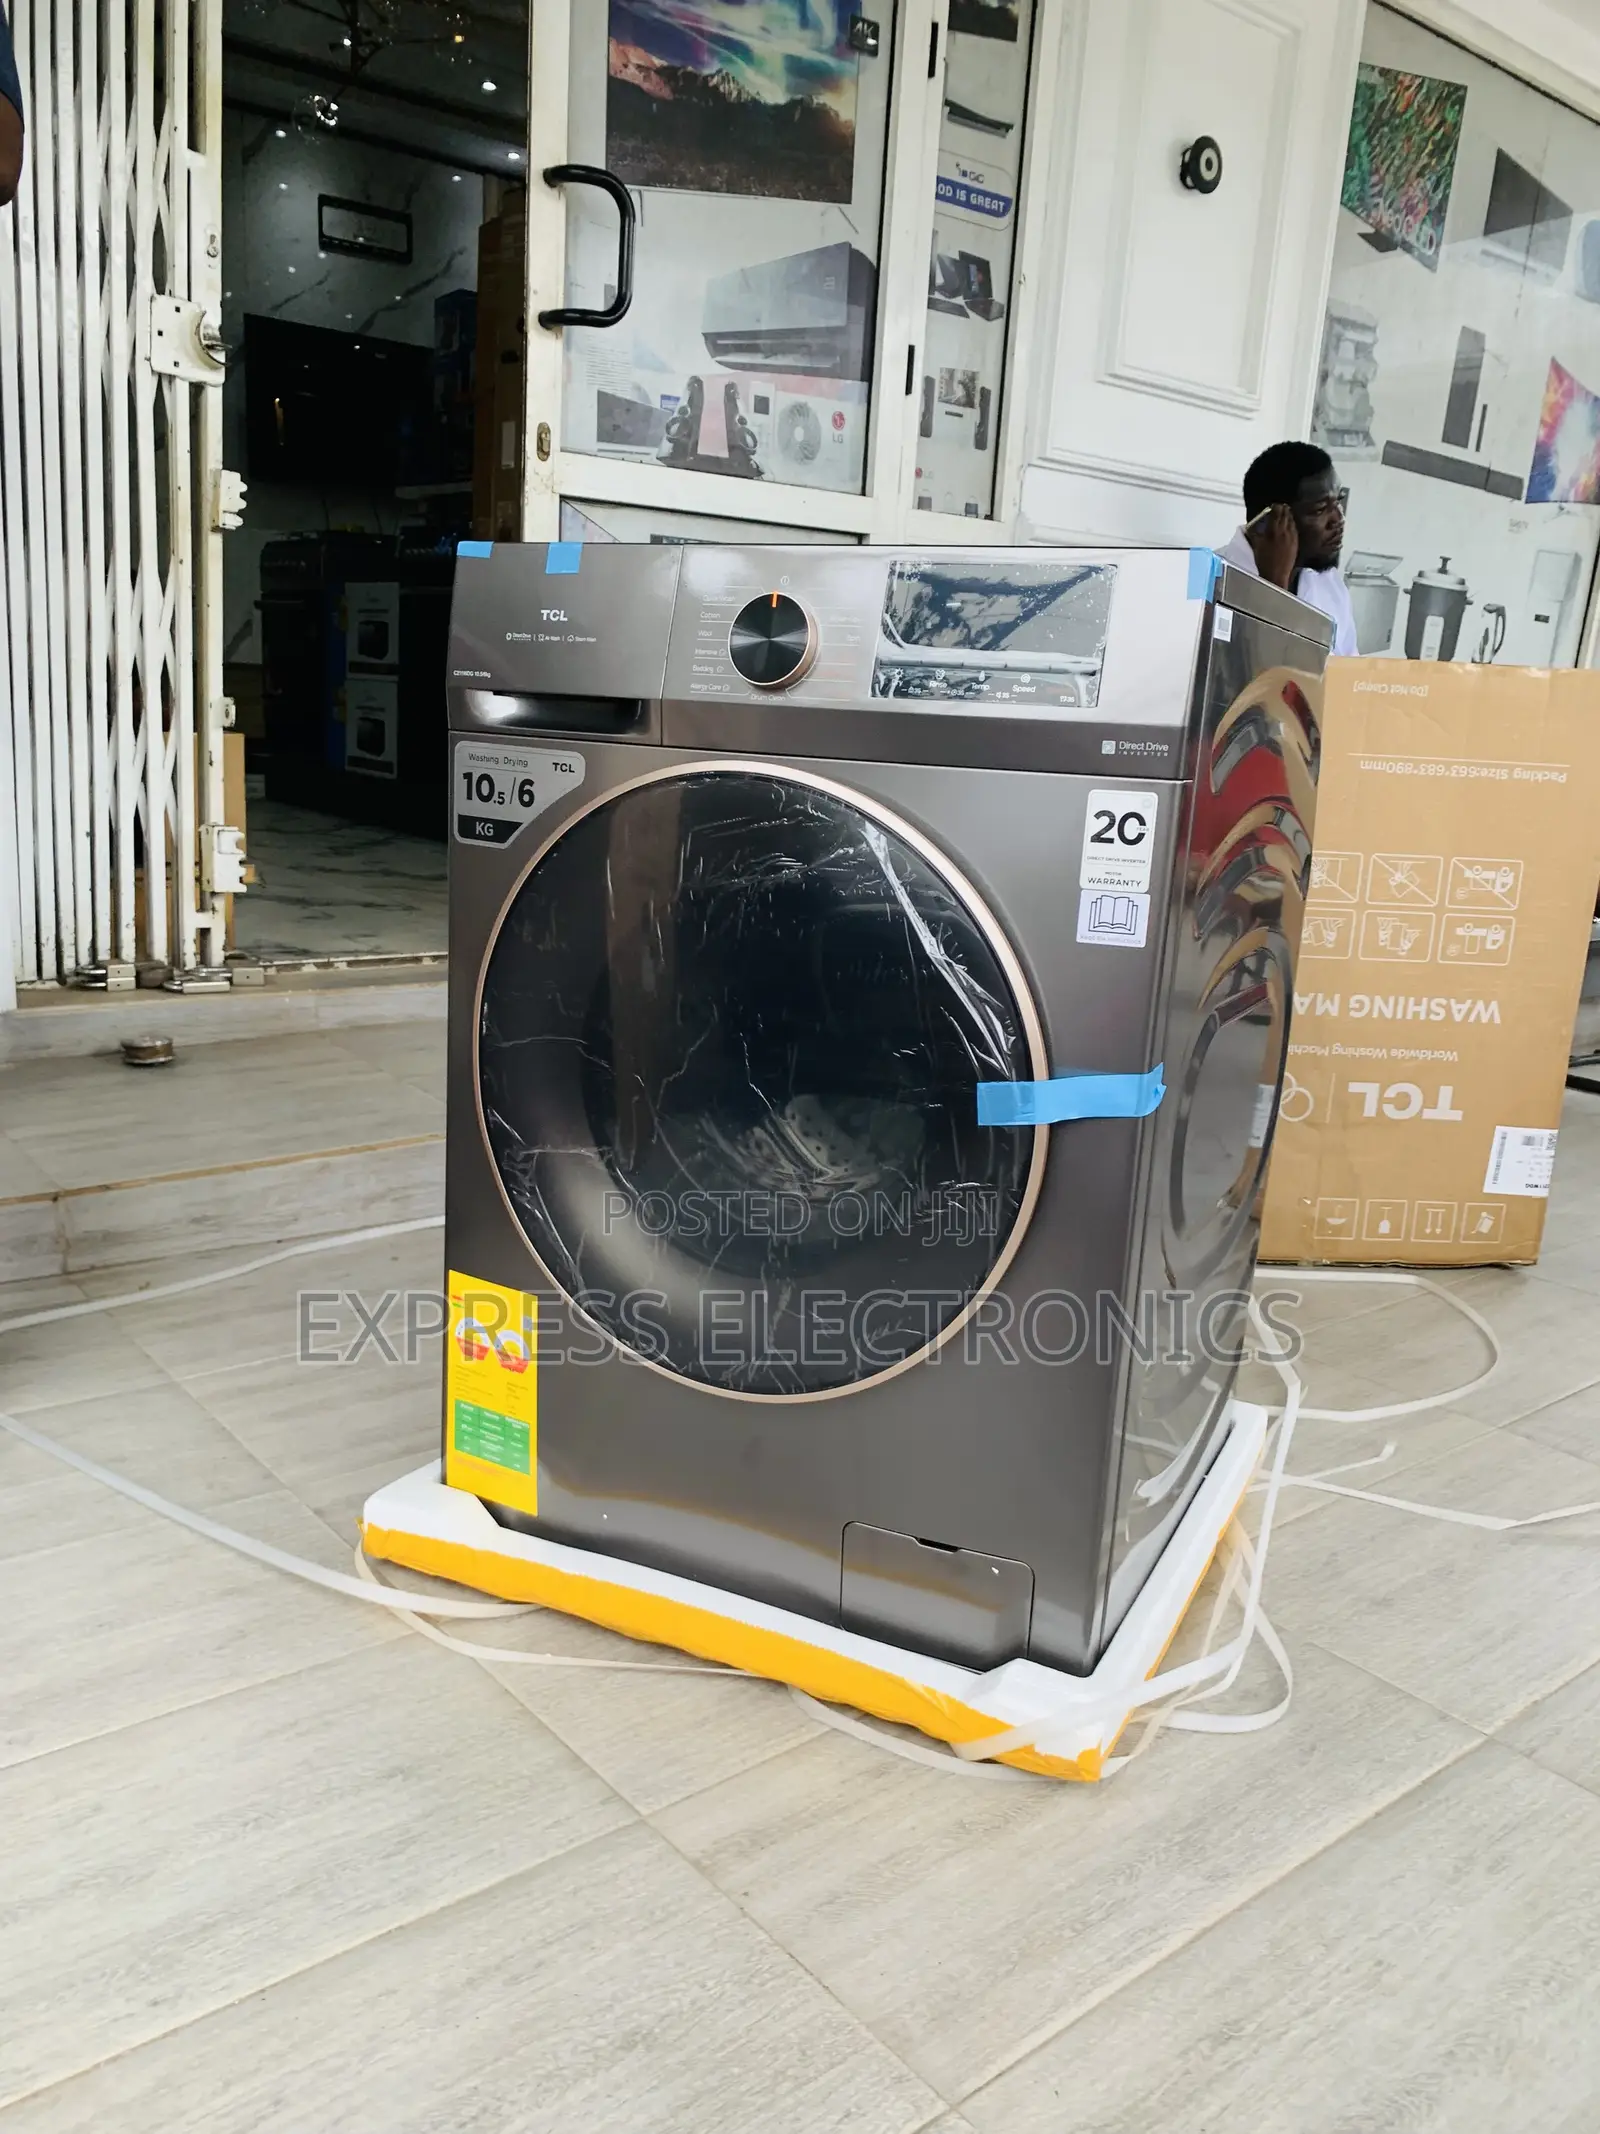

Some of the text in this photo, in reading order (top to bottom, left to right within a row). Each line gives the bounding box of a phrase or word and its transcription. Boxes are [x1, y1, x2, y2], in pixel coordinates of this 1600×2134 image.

[936, 182, 1005, 213] OD IS GREAT
[832, 432, 844, 444] LG
[541, 609, 568, 621] TCL
[700, 611, 720, 619] Cotton
[971, 683, 990, 692] Temp
[1012, 684, 1036, 693] Speed
[1119, 740, 1169, 752] Direct Drive
[468, 753, 528, 768] Washing Drying
[552, 762, 575, 773] TCL
[1513, 767, 1568, 783] Packing
[475, 822, 494, 836] KG
[1087, 877, 1142, 887] WARRANTY
[1348, 994, 1501, 1024] WASHING
[1332, 1043, 1388, 1060] Washing
[1390, 1048, 1458, 1062] Worldwide
[1348, 1081, 1463, 1121] TCL
